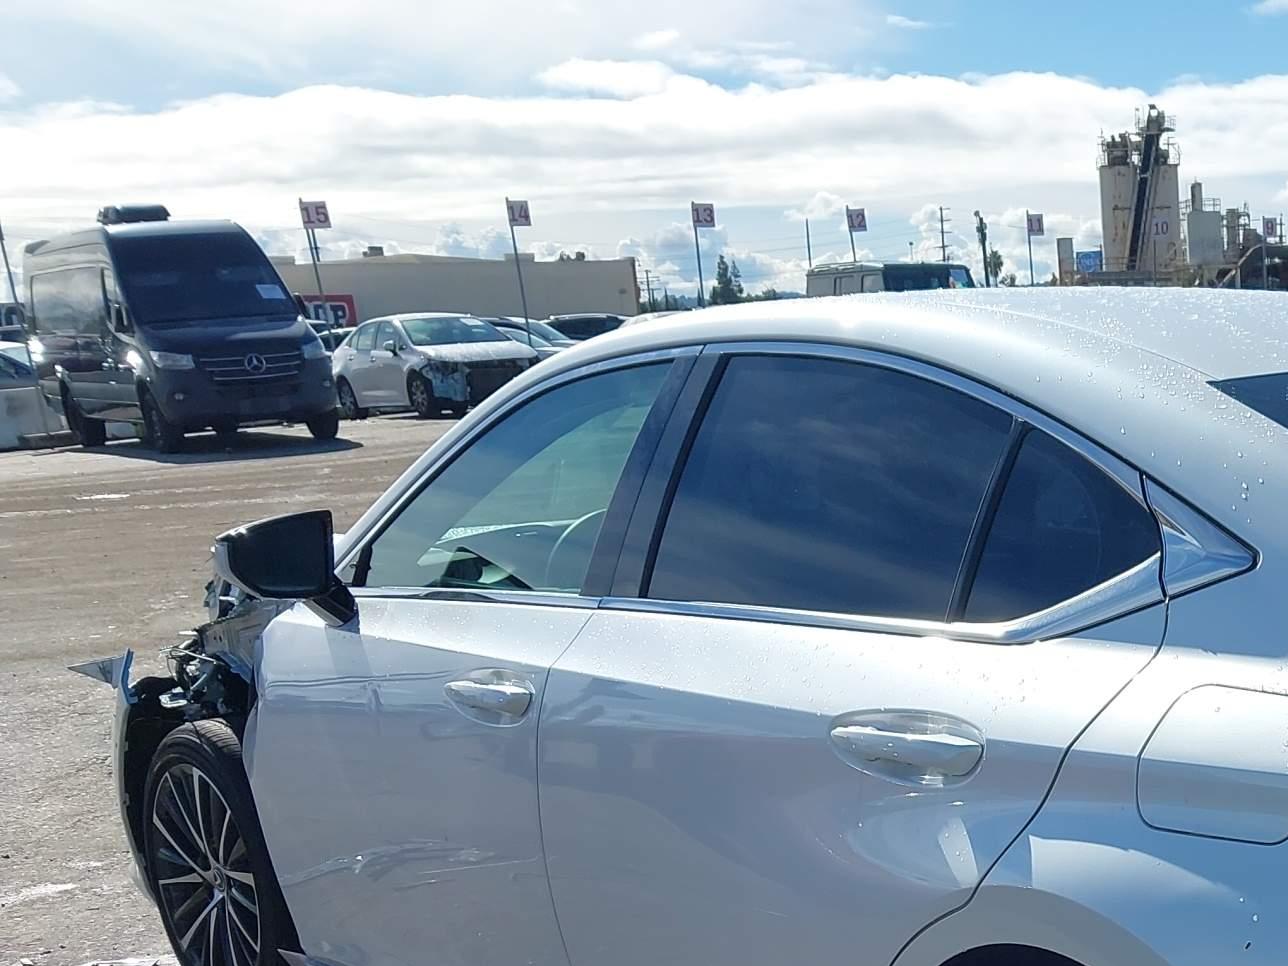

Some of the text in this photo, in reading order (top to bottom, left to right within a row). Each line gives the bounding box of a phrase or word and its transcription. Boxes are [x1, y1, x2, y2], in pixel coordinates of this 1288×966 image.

[302, 205, 329, 225] 15
[509, 205, 530, 223] 14
[692, 207, 714, 225] 13
[847, 213, 867, 230] 12
[1027, 217, 1044, 233] 11
[1153, 221, 1169, 236] 10
[1266, 220, 1274, 235] 9
